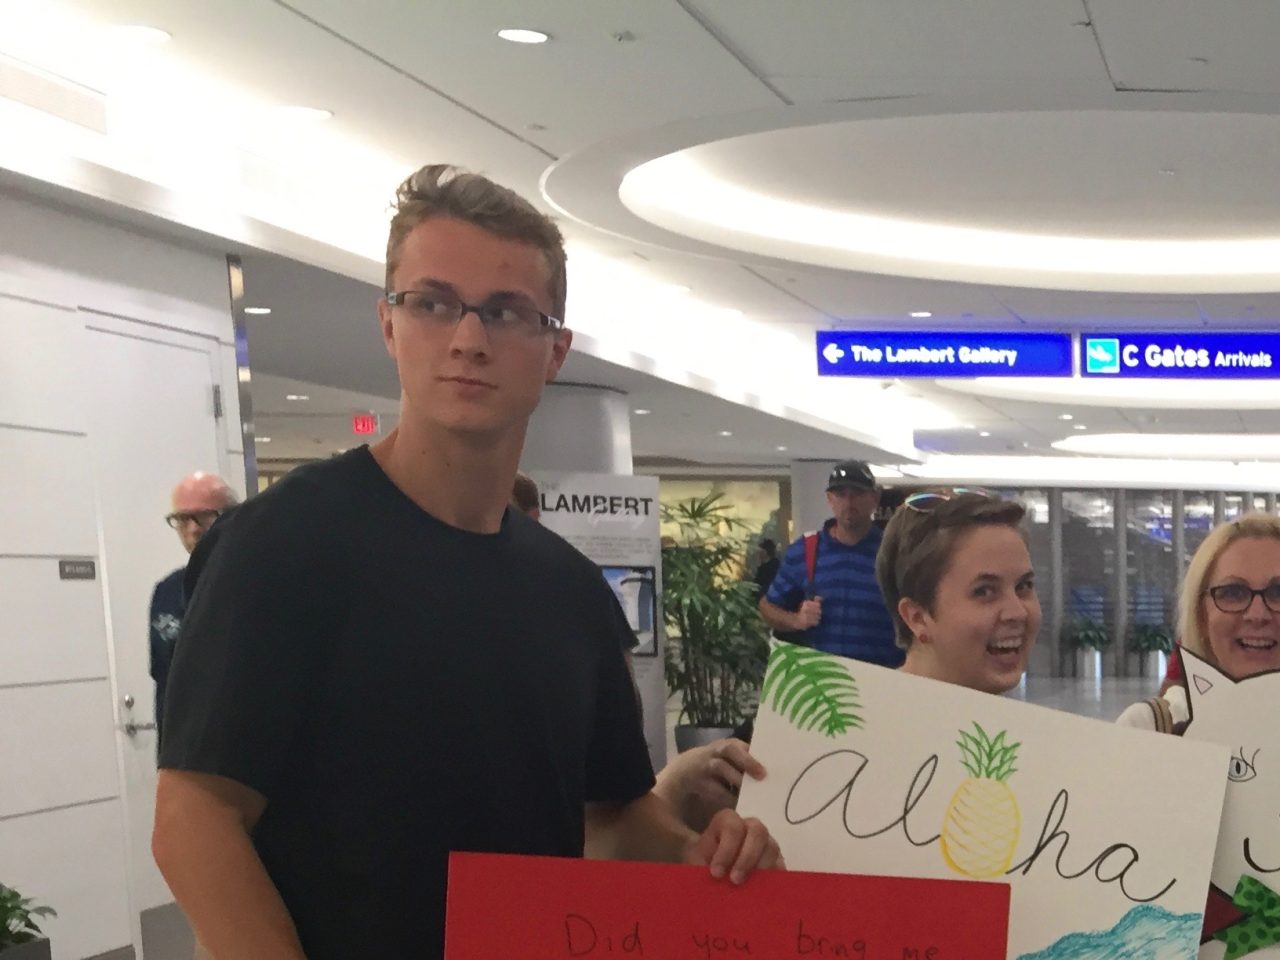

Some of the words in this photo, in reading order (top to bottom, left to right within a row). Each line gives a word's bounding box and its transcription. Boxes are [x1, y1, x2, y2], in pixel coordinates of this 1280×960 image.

[851, 345, 882, 363] The
[886, 345, 955, 363] Lambert
[958, 346, 1018, 366] Gallery
[1122, 344, 1140, 367] C
[1145, 344, 1210, 367] Gates
[1214, 351, 1273, 367] Arrivals
[541, 493, 653, 516] LAMBERT
[564, 913, 644, 957] Did
